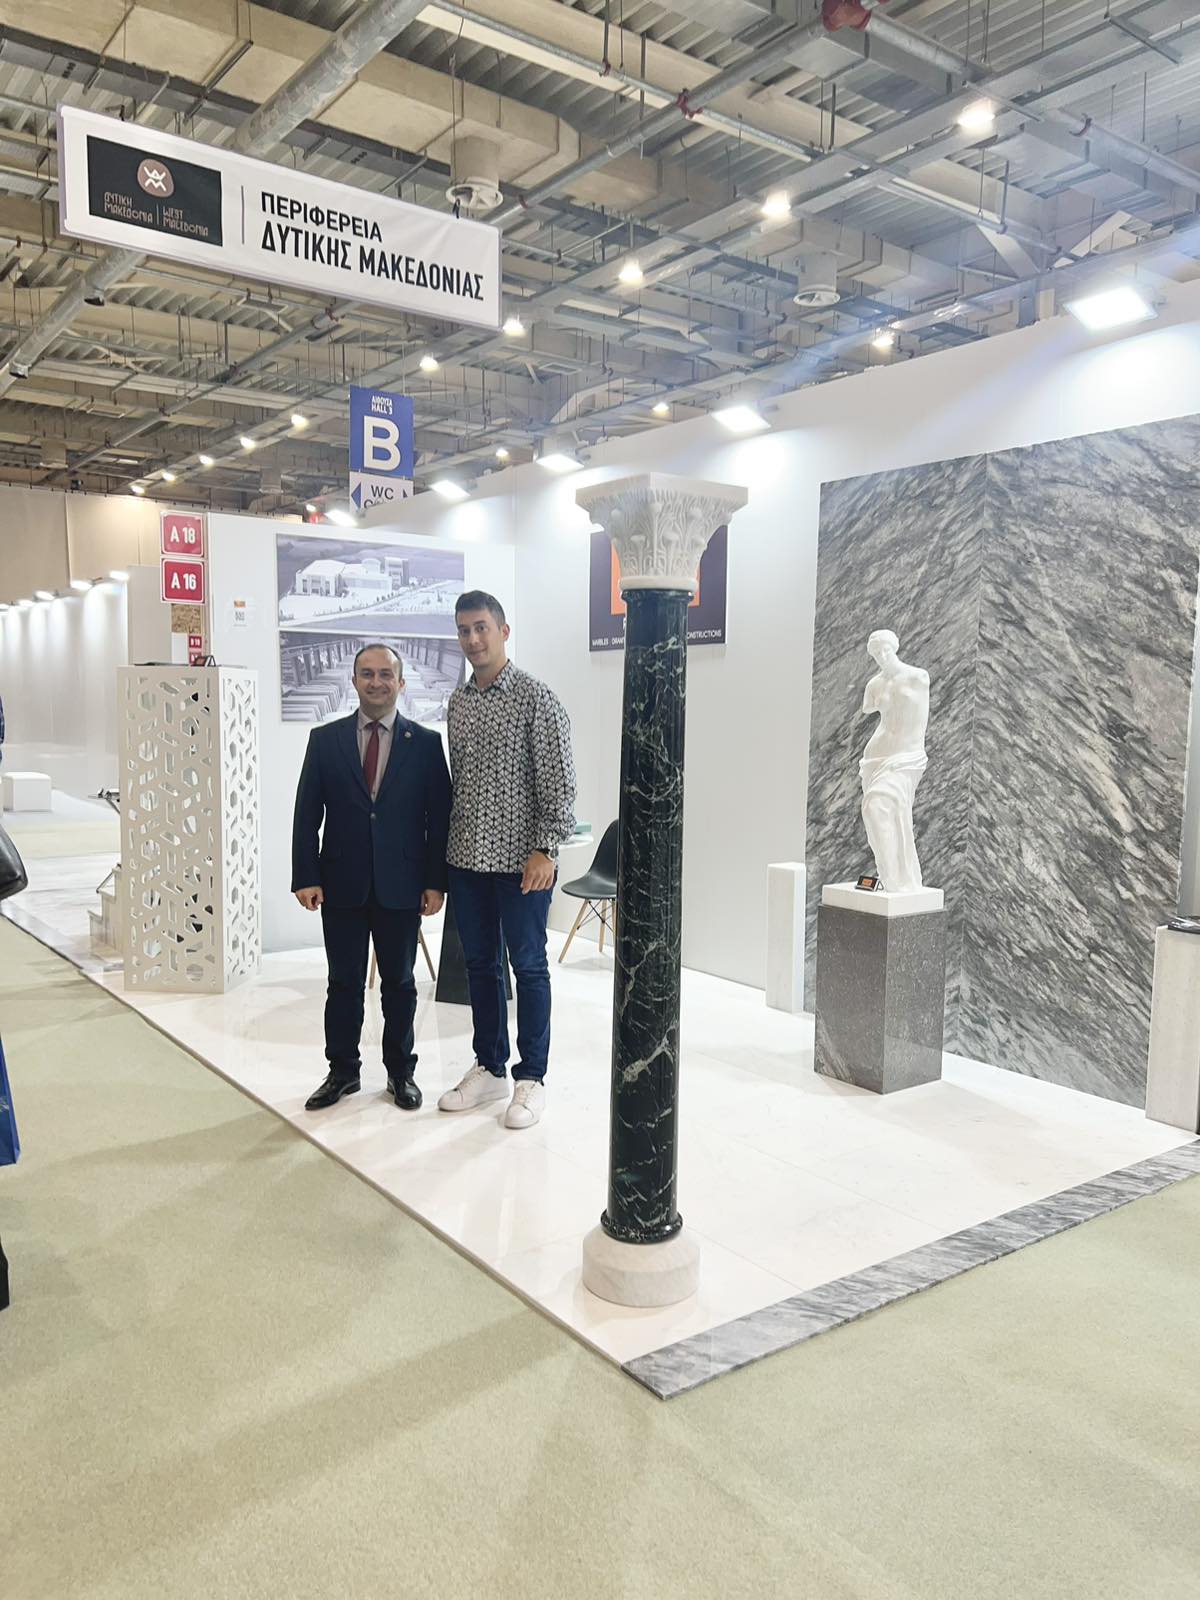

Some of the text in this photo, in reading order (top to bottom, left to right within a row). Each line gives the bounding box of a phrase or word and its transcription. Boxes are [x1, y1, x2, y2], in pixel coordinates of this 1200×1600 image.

[162, 206, 183, 219] WEST
[261, 191, 383, 243] ΠΕΡΙΦΕΡΕΙΑ
[261, 220, 484, 301] ΔΥΤΙΚΗΣ ΜΑΚΕΔΟΝΙΑΣ
[371, 484, 394, 500] WC
[170, 525, 196, 544] A 18
[171, 572, 197, 590] A 16
[686, 629, 722, 640] ONSTRUCTIONS
